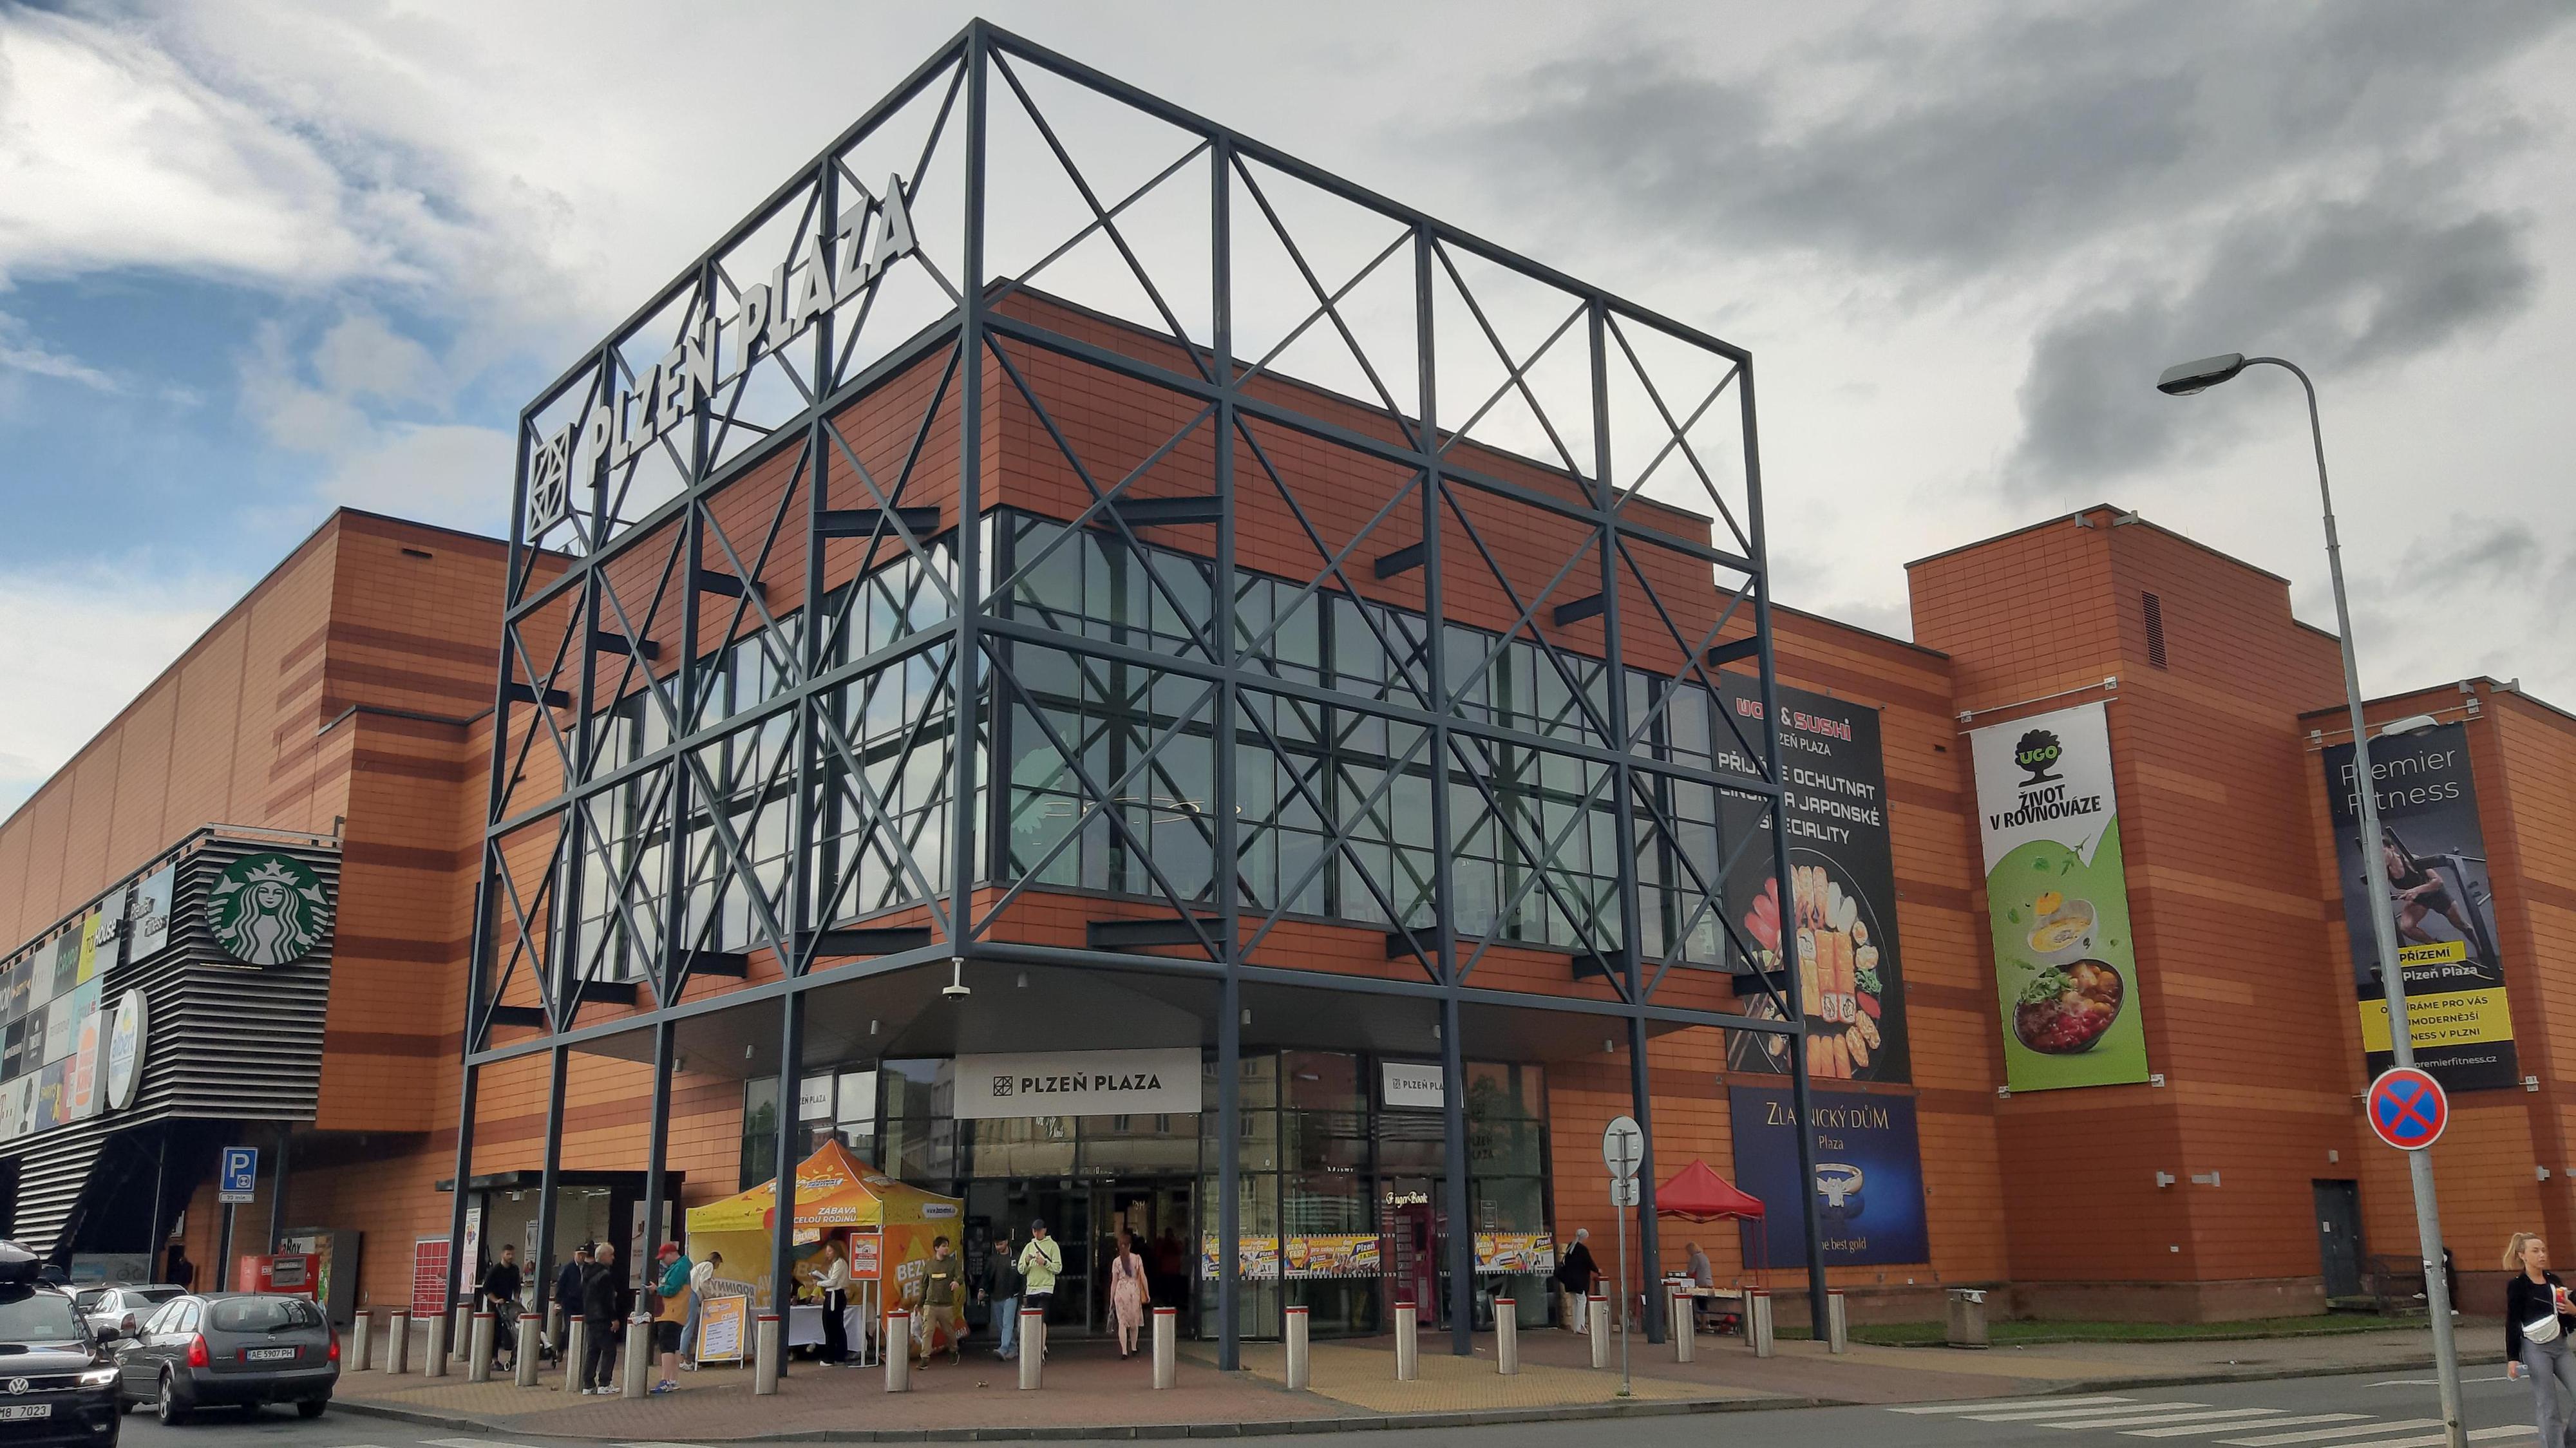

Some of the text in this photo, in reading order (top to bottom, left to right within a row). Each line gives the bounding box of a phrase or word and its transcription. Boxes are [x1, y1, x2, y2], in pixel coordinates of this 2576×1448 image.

[587, 172, 916, 488] PLZEŇ PLAZA
[1781, 706, 1791, 726] &
[1779, 732, 1832, 757] ZEŇ PLAZA
[2018, 745, 2058, 765] UGO
[2340, 749, 2456, 787] Pemier
[1793, 767, 1875, 800] OCHUTNAT
[2018, 784, 2066, 809] ŽIVOT
[2346, 780, 2461, 816] Ftness
[1784, 791, 1796, 809] A
[1799, 796, 1880, 827] JAPONSKÉ
[1989, 795, 2102, 831] V ROVNOVÁZE
[1759, 814, 1850, 845] SECIALITY
[2398, 946, 2451, 963] PŘÍZEMÍ
[2403, 966, 2478, 982] Plzeň Plaza
[2380, 996, 2488, 1015] OÍRÁME PRO VÁS
[2410, 1031, 2438, 1041] NESS
[2450, 1028, 2480, 1037] PLZNI
[1021, 1071, 1161, 1093] PLZEŇ PLAZA
[1403, 1079, 1444, 1090] PLZEŇ PLA
[810, 1095, 826, 1104] PLAZA
[1766, 1102, 1889, 1129] ZLANICKÝ DŮM
[1818, 1134, 1844, 1150] Plaza
[230, 1153, 250, 1178] P
[817, 1205, 857, 1215] ZÁBAVA
[822, 1215, 857, 1223] RODINU
[1356, 1241, 1376, 1253] Plzeň
[1830, 1237, 1848, 1250] best
[1848, 1237, 1866, 1254] gold
[20, 1406, 46, 1417] 7023
